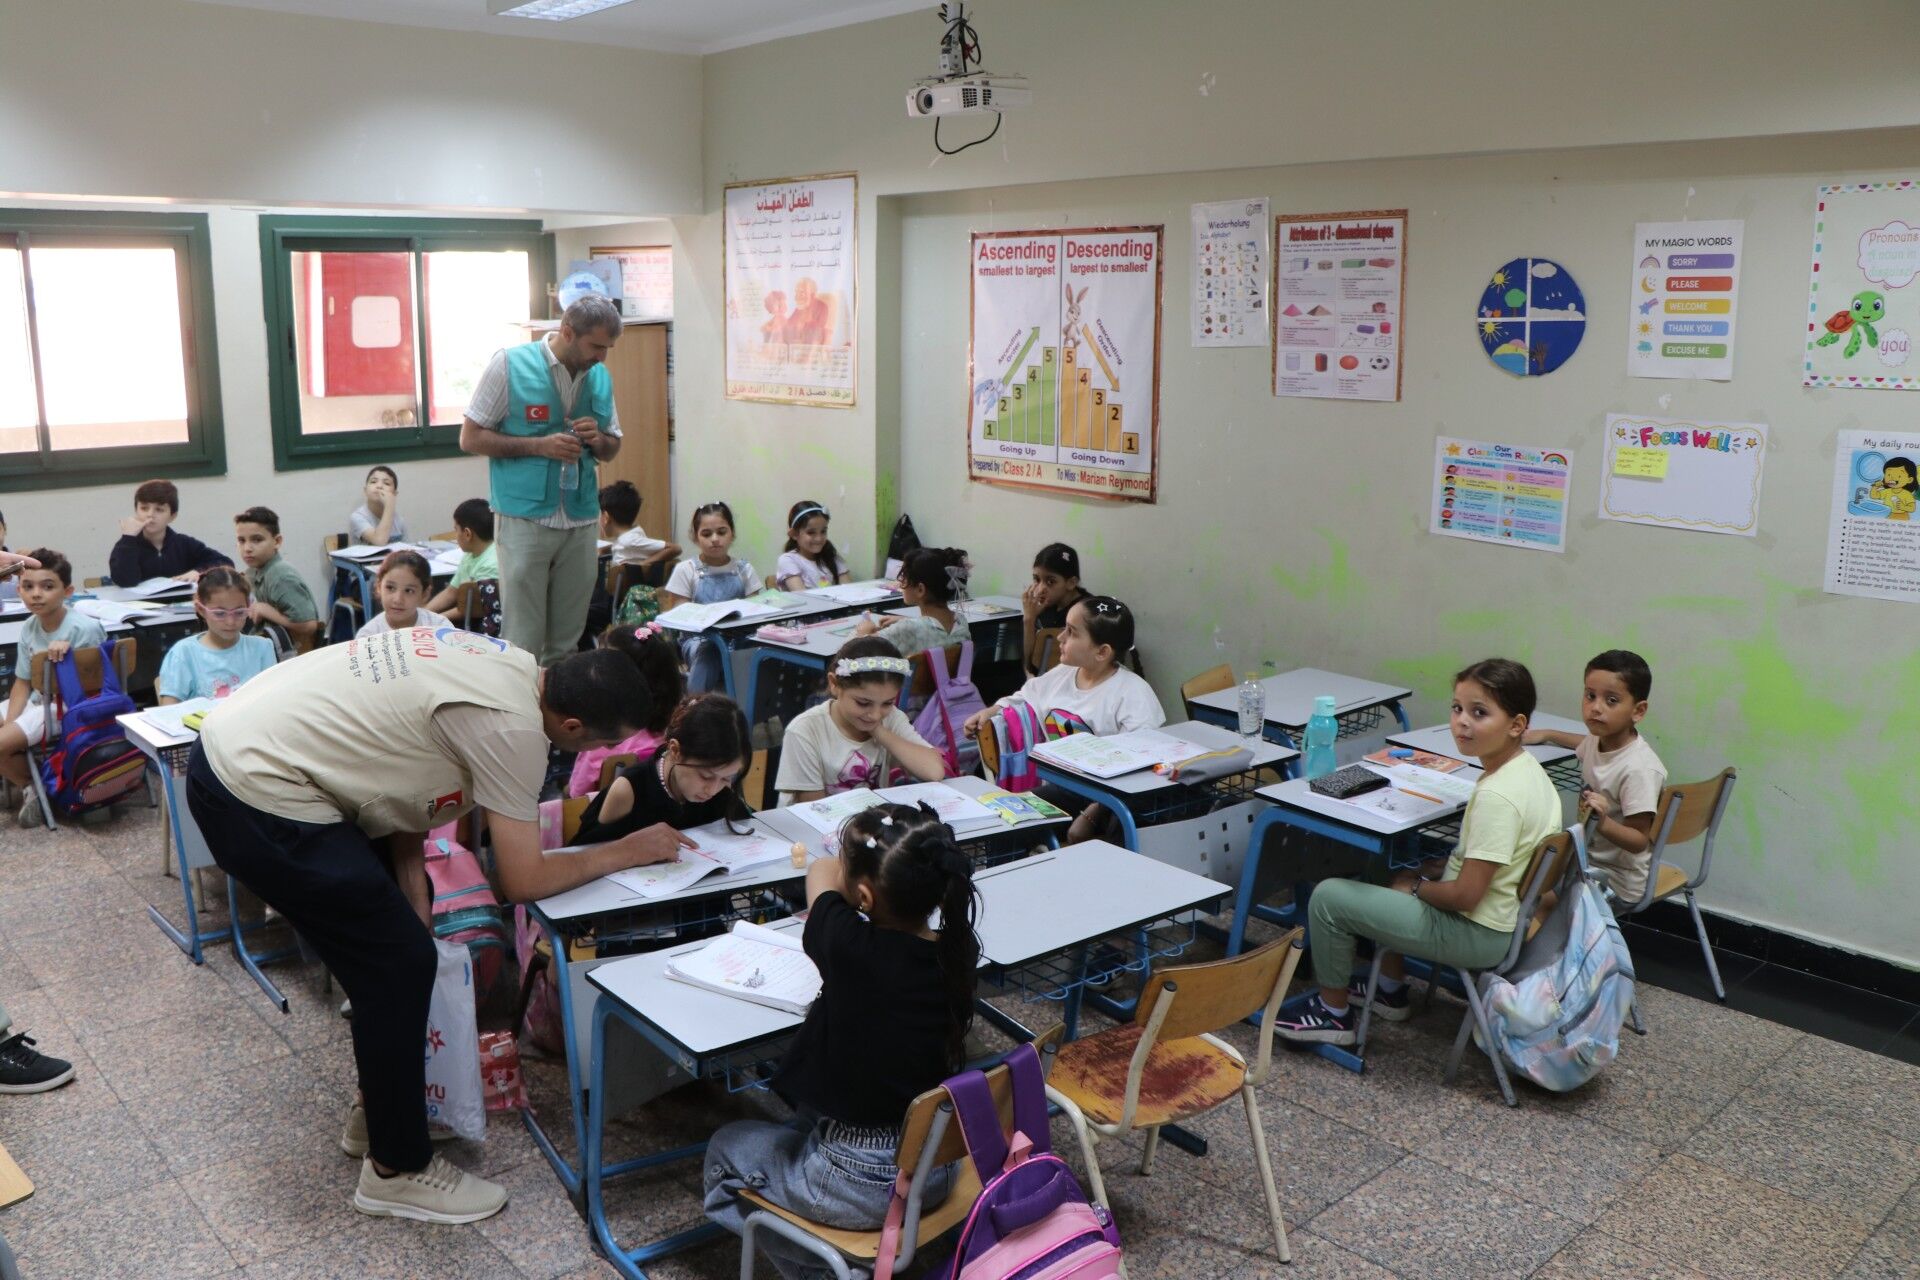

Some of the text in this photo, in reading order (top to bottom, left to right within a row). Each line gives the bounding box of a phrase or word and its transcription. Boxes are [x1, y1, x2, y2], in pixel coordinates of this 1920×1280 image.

[1208, 219, 1250, 230] Wiederholung
[1645, 237, 1733, 248] MY MAGIC WORDS
[979, 242, 1057, 263] Ascending
[1066, 240, 1154, 261] Descending
[1070, 262, 1148, 275] largest to smallest
[1672, 258, 1698, 266] SORRY
[979, 265, 1056, 277] smallest to largest
[1671, 280, 1700, 288] PLEASE
[1670, 302, 1708, 310] WELCOME
[1668, 324, 1712, 333] THANK YOU
[1666, 346, 1710, 354] EXCUSE ME
[1881, 339, 1907, 356] you
[1045, 350, 1052, 363] 5
[1066, 350, 1073, 363] 5
[1029, 369, 1036, 382] 4
[1080, 372, 1088, 385] 4
[1015, 387, 1022, 400] 3
[1096, 392, 1103, 406] 3
[1000, 400, 1008, 412] 2
[1112, 406, 1119, 421] 2
[986, 424, 994, 436] 1
[1126, 437, 1134, 450] 1
[1640, 427, 1732, 452] Focus Wall
[1864, 438, 1920, 450] My daily rou
[1000, 444, 1036, 456] Going Up
[1468, 448, 1512, 458] Classroom
[1494, 445, 1511, 453] Our
[1072, 452, 1125, 466] Going Down
[1004, 461, 1024, 476] Class
[1036, 464, 1042, 478] A
[1080, 472, 1106, 485] Mariam
[1109, 475, 1150, 492] Reymond
